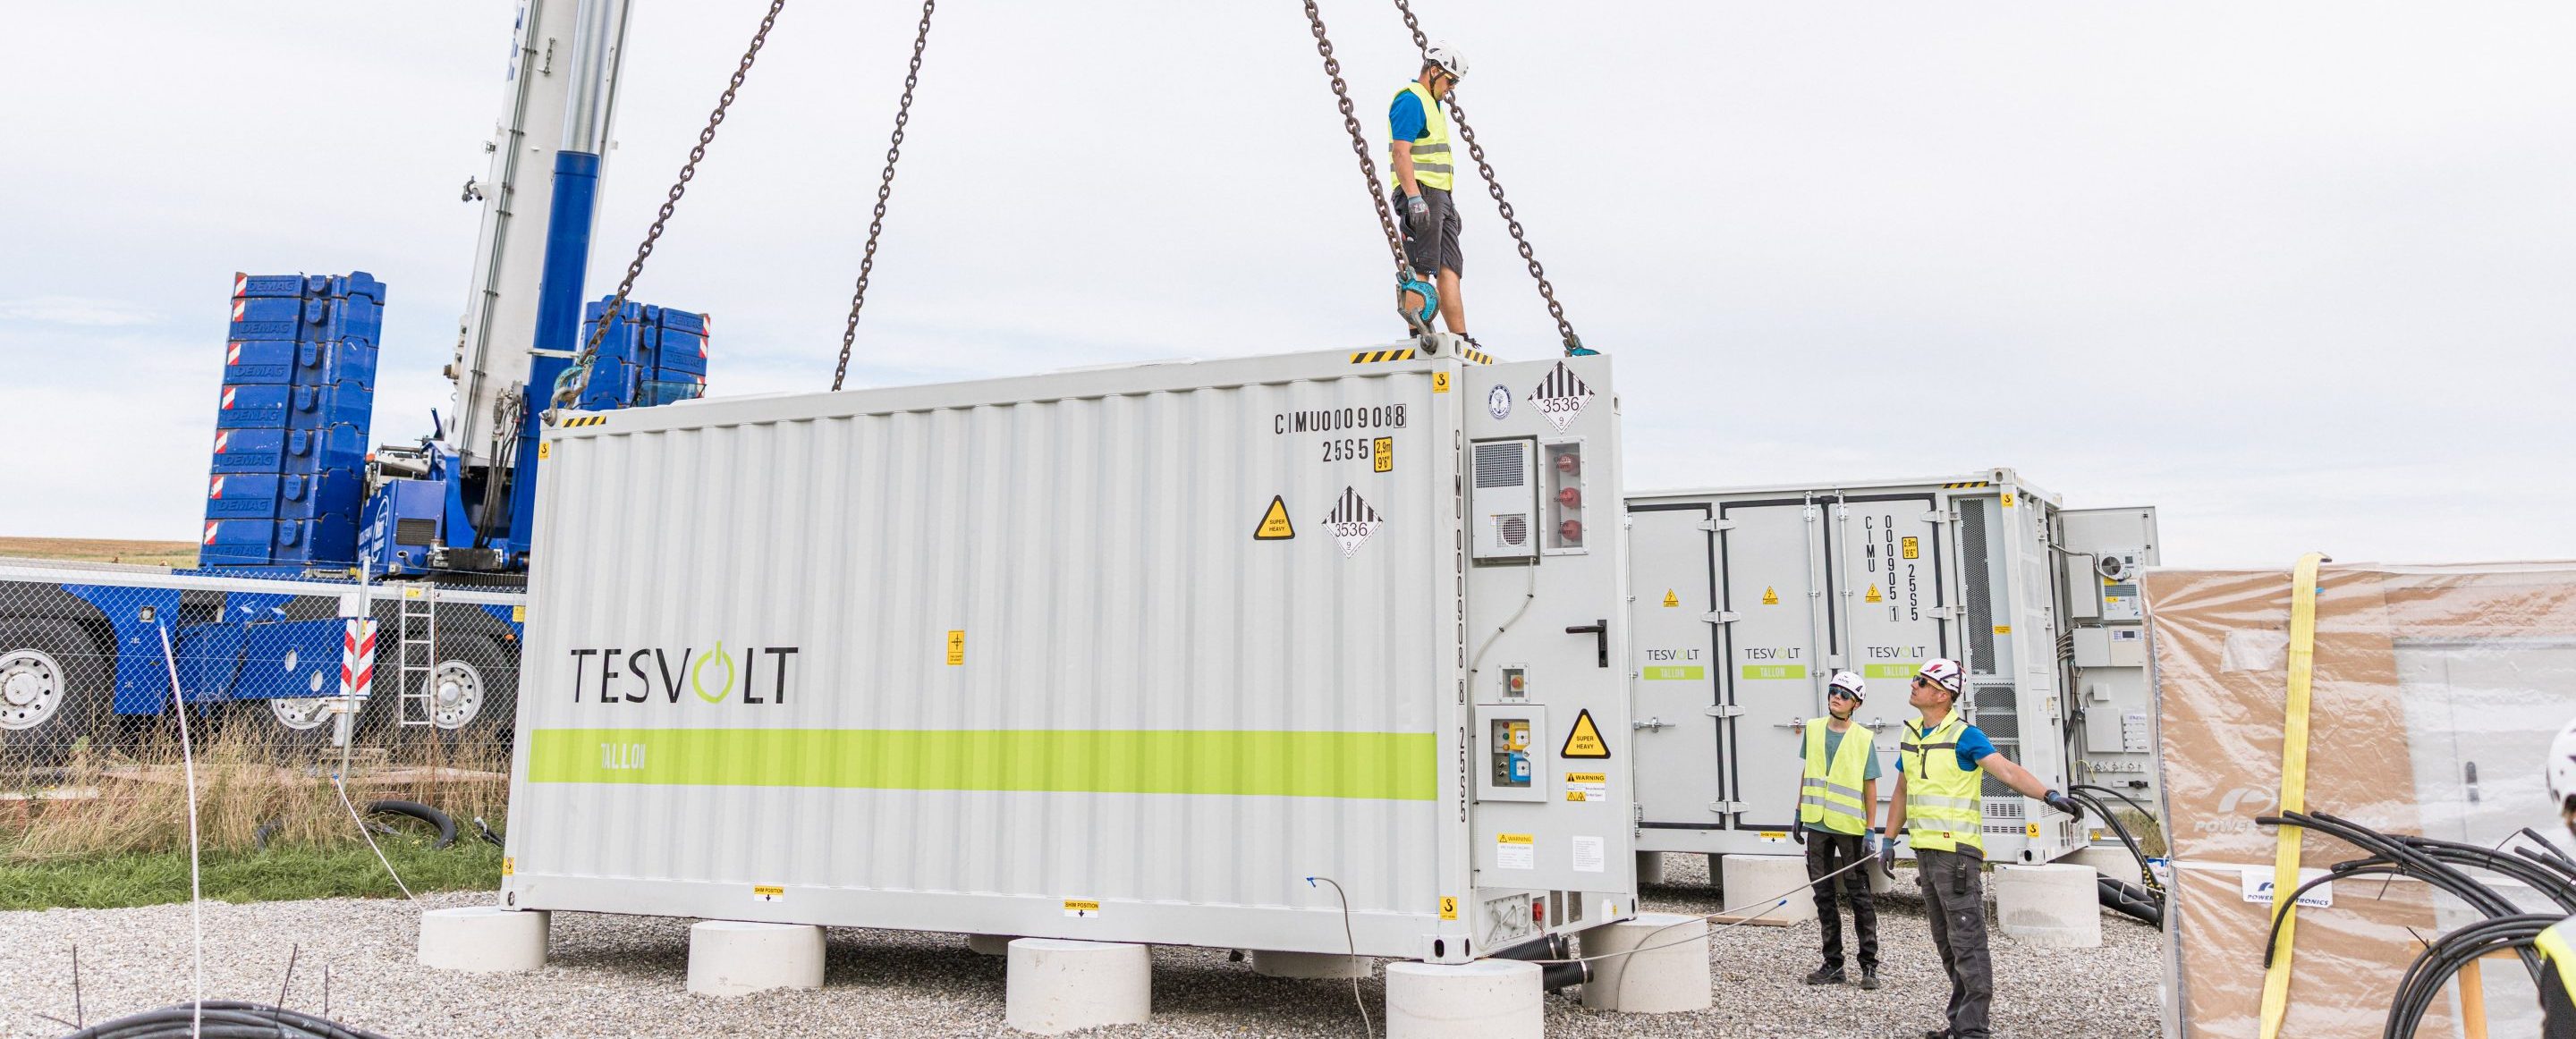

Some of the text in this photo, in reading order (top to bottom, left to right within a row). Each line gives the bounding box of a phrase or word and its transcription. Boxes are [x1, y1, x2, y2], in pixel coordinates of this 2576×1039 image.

[246, 281, 295, 292] DEMAG
[240, 322, 291, 334] DEMAG
[235, 365, 285, 376] DEMAG
[1543, 396, 1580, 413] 3536
[228, 409, 279, 421] DEMAG
[1323, 439, 1368, 462] 25S5
[224, 454, 275, 466] DEMAG
[218, 500, 269, 511] DEMAG
[1335, 522, 1368, 536] 3536
[1647, 646, 1699, 661] TESVOLT
[1745, 646, 1801, 660] TESVOLT
[1868, 646, 1926, 658] TESVOLT
[571, 640, 799, 704] TESVOLT
[600, 743, 646, 769] TALLON
